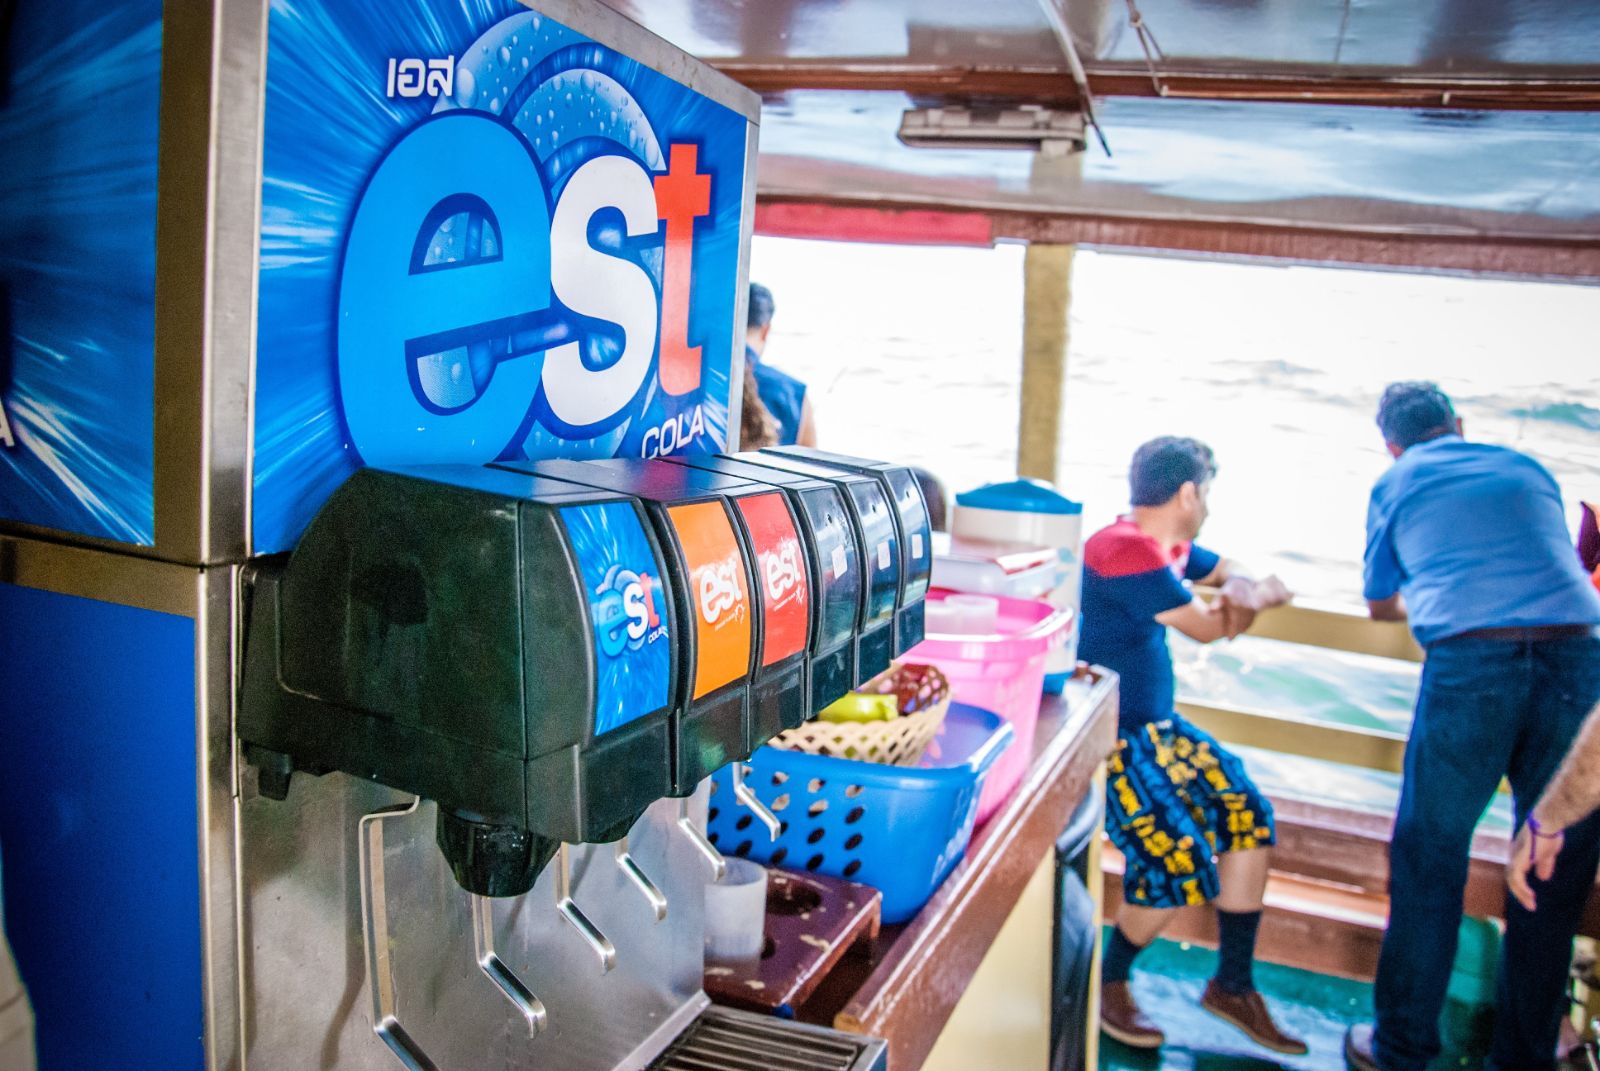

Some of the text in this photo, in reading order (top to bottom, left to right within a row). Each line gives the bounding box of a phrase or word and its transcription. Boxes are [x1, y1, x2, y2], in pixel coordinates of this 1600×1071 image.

[386, 55, 455, 98] เอส
[338, 115, 712, 466] est
[641, 404, 705, 460] COLA
[700, 556, 743, 624] est
[766, 541, 801, 600] est
[598, 572, 660, 657] est
